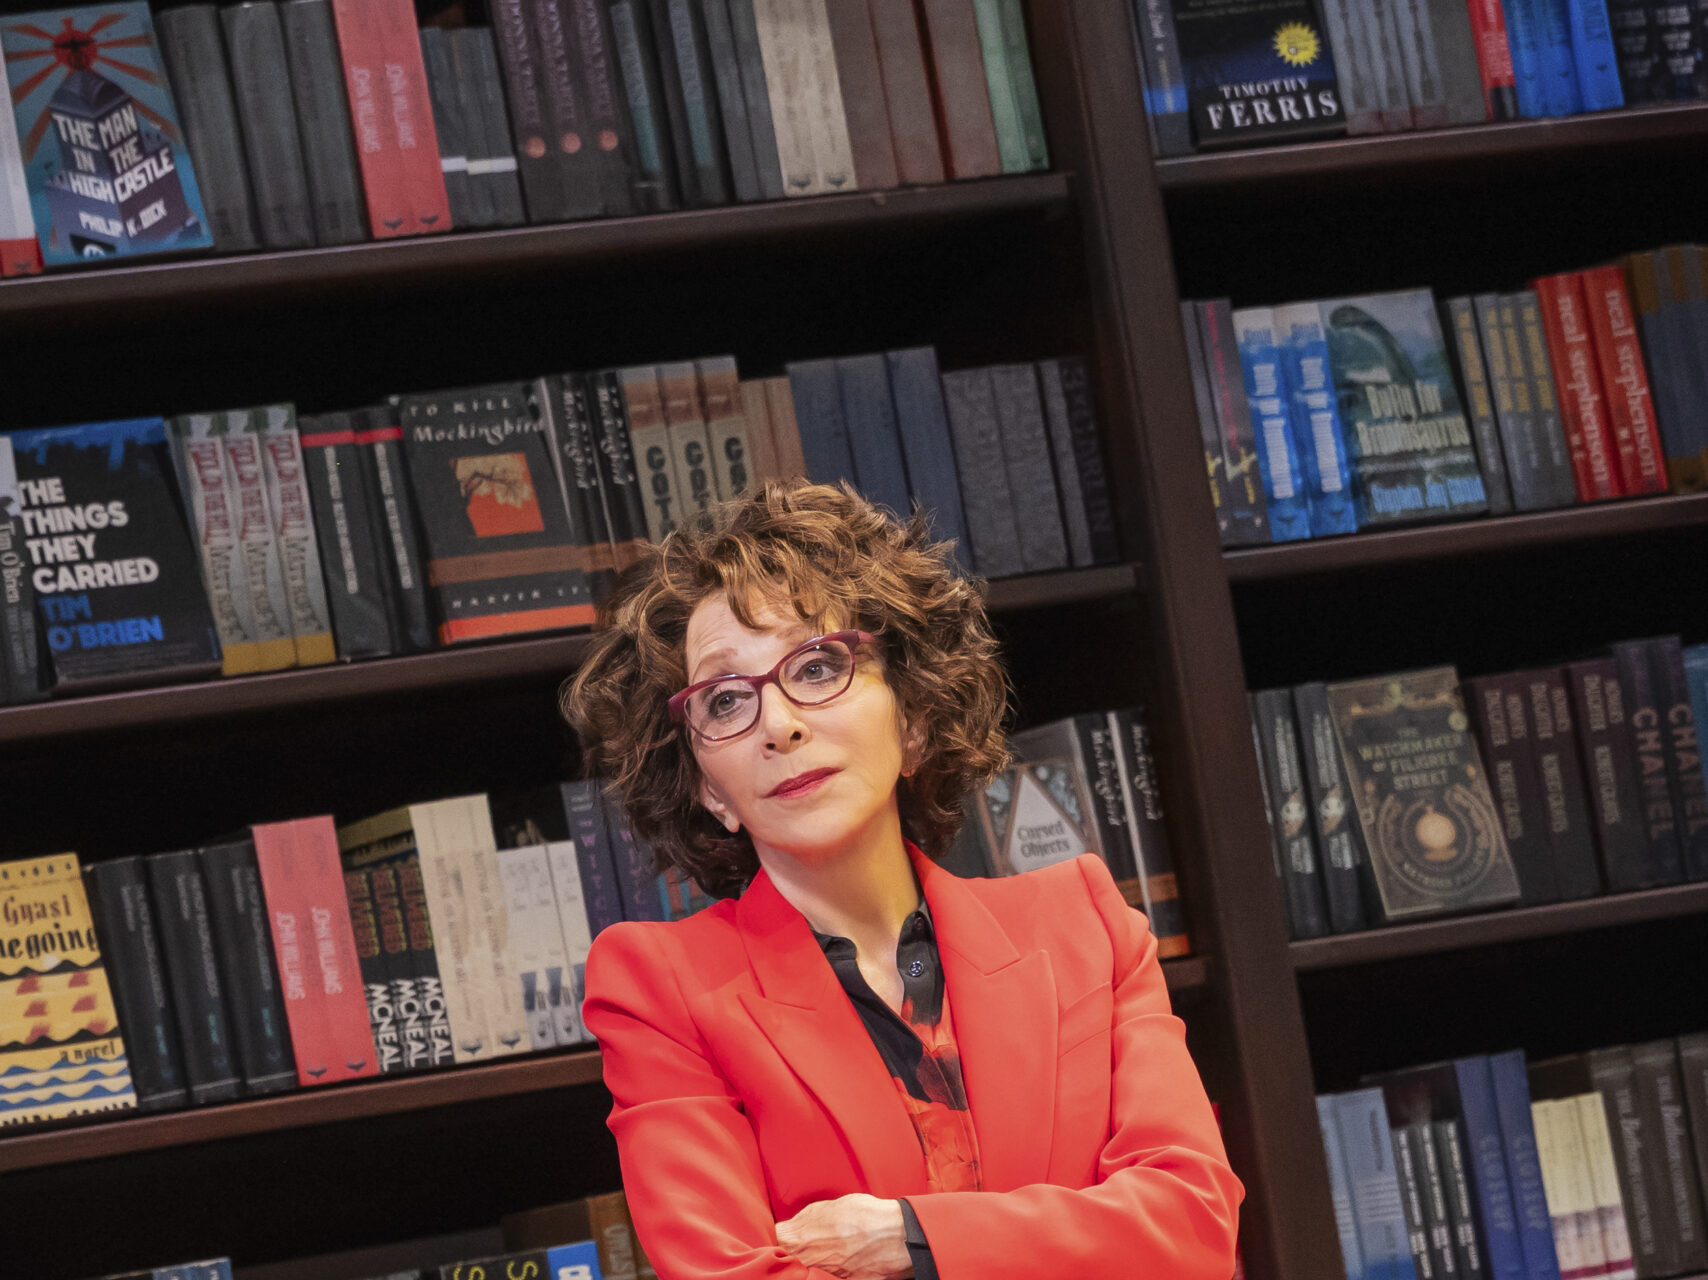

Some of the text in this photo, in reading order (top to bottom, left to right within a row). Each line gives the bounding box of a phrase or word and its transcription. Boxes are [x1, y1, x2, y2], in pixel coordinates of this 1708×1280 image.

[1219, 77, 1309, 99] TIMOTHY
[52, 104, 138, 149] THE MAN
[1207, 90, 1338, 130] FERRIS
[72, 134, 144, 176] IN THE
[70, 147, 174, 203] HIGH CASTLE
[79, 210, 122, 238] PHILIP
[1558, 296, 1607, 485] neal stephenson
[1606, 290, 1657, 476] neal stephenson
[410, 403, 438, 418] TO
[453, 399, 510, 414] KILL
[413, 417, 545, 447] Mockingbird
[17, 478, 64, 507] THE
[20, 501, 129, 536] THINGS
[26, 533, 95, 565] THEY
[1, 551, 24, 604] O'Brien
[33, 557, 159, 593] CARRIED
[39, 595, 92, 622] TIM
[48, 616, 164, 651] O'BRIEN
[1359, 734, 1463, 761] WATCHMAKER
[1393, 770, 1449, 791] STREET
[1017, 821, 1065, 840] Cursed
[1020, 838, 1071, 857] Objects
[3, 894, 71, 926] Gyasi
[0, 922, 100, 959] egoing
[367, 982, 400, 1072] MCNEAL
[396, 979, 430, 1068] MCNEAL
[422, 977, 451, 1066] MCNEAL
[74, 1041, 116, 1057] novel
